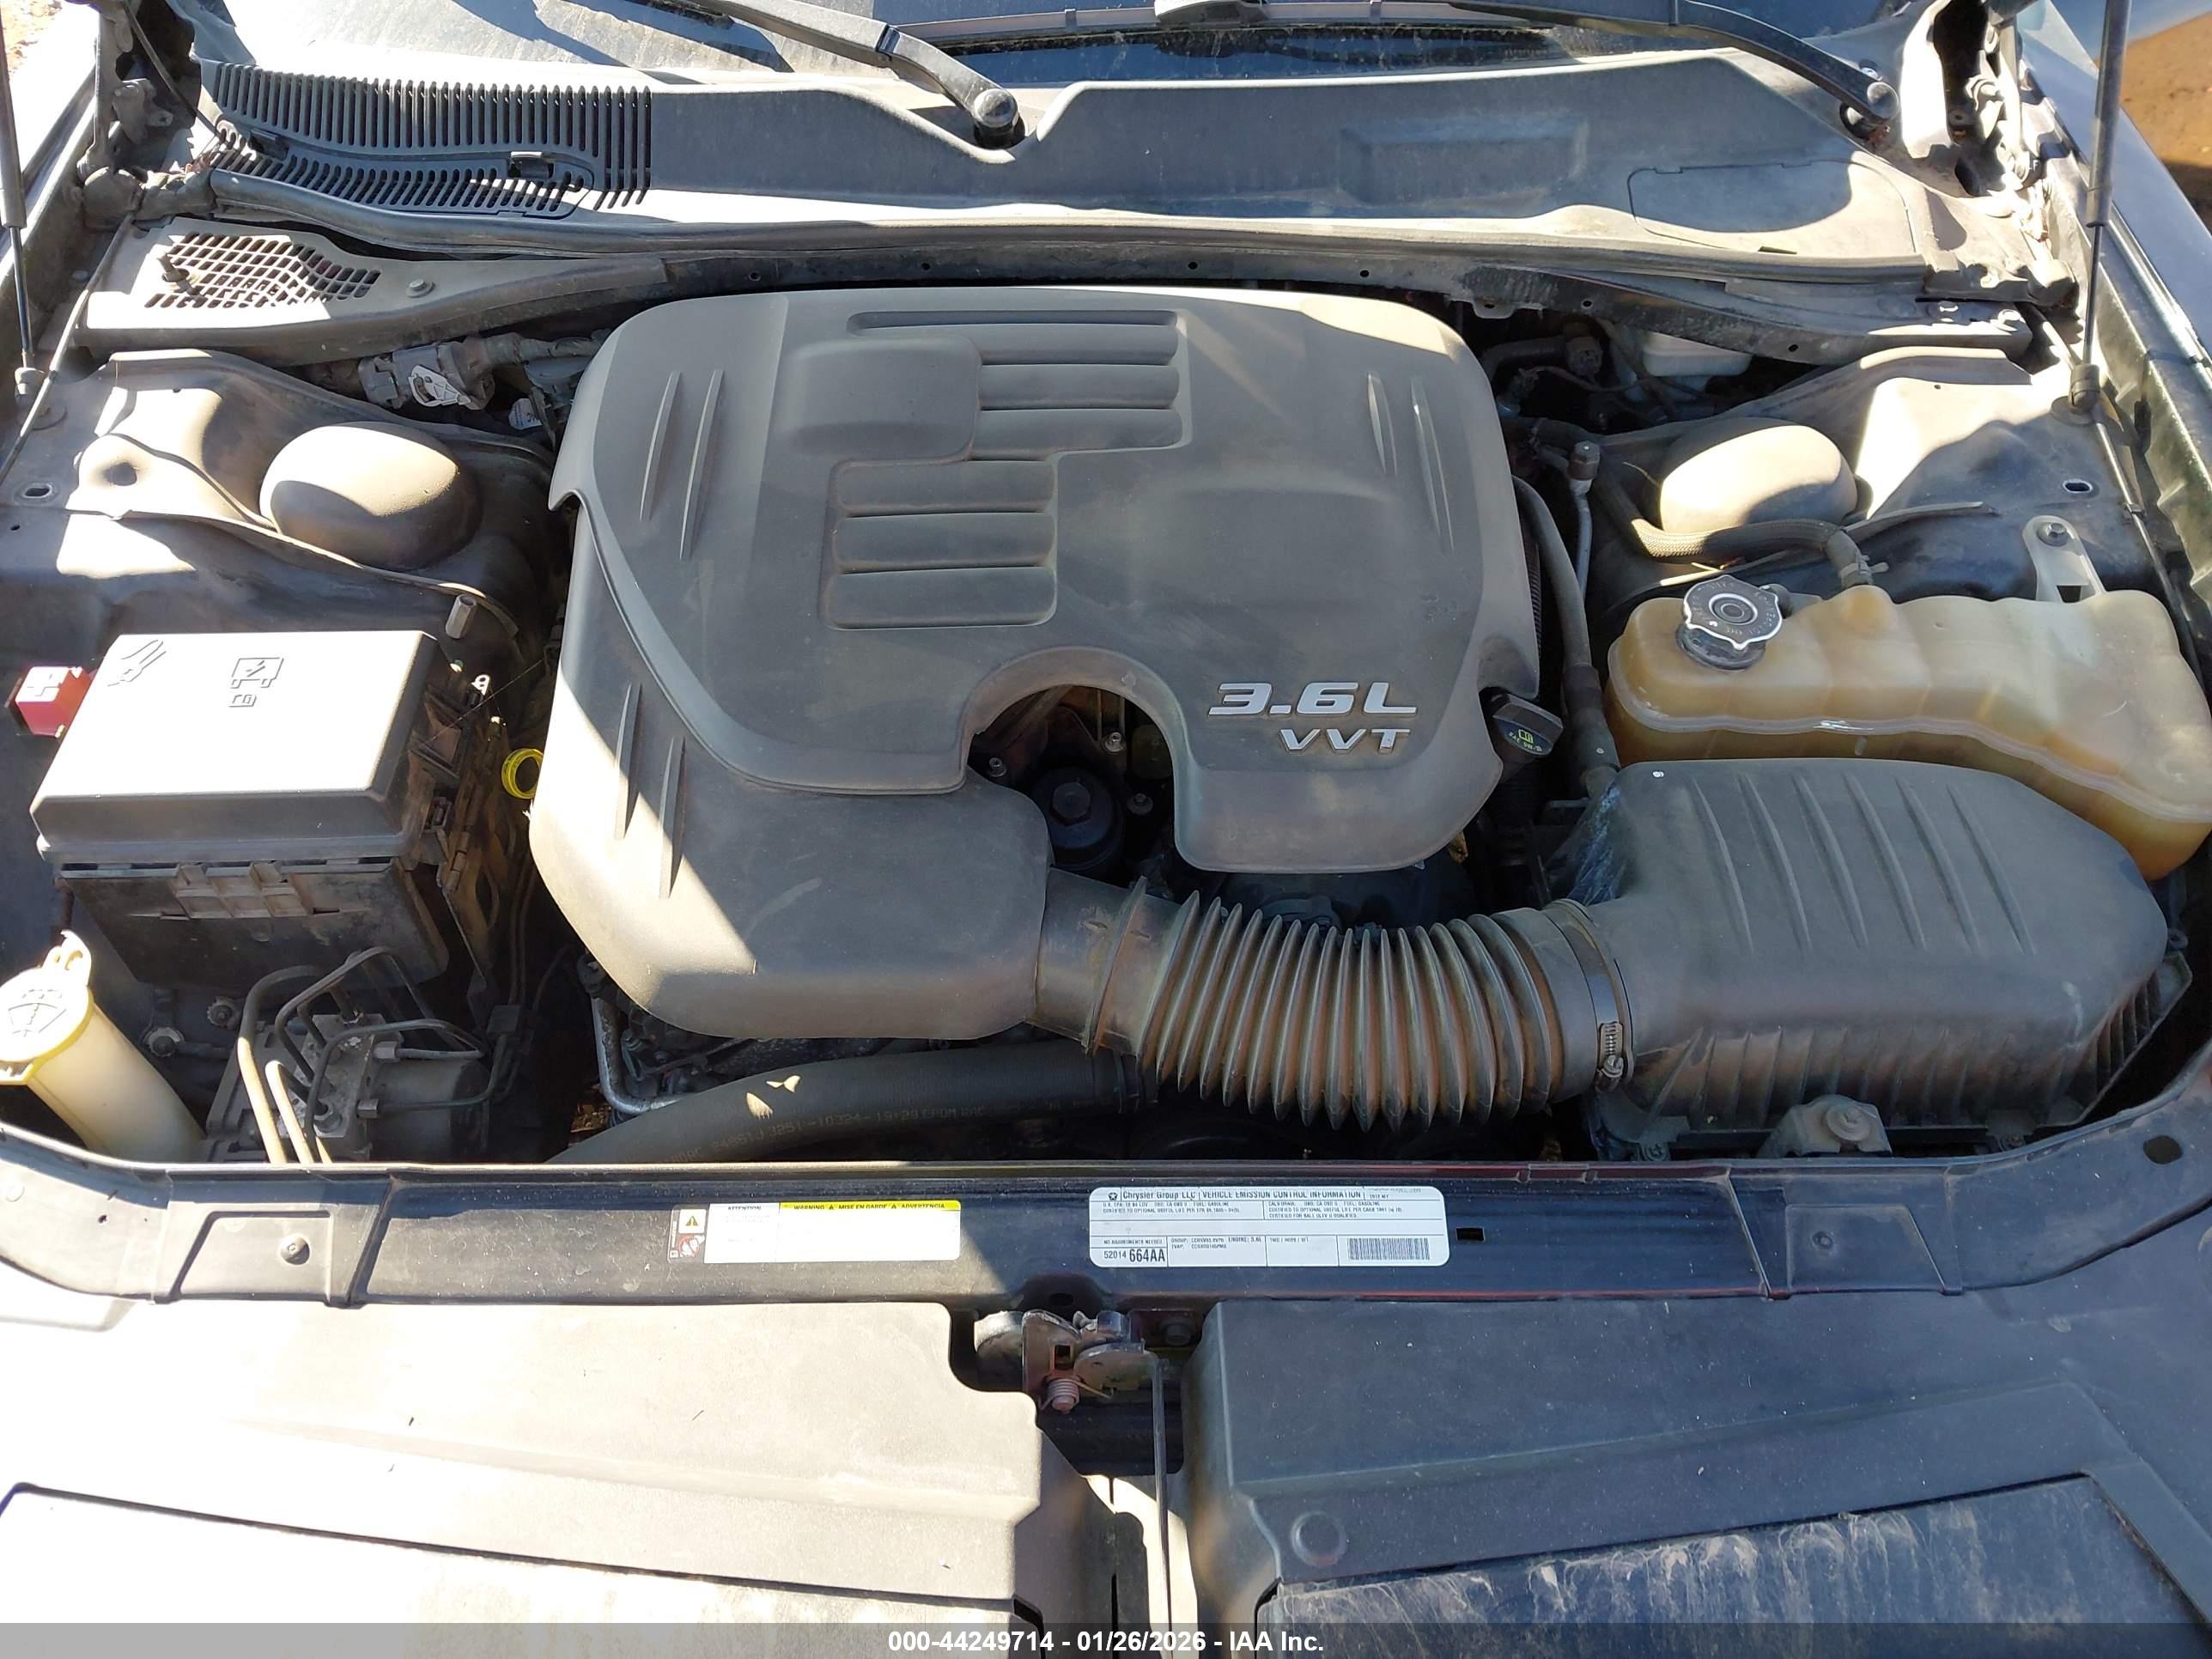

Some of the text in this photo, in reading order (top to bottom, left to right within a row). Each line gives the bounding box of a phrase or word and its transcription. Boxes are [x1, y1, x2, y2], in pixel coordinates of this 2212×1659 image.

[1208, 682, 1417, 715] 3.6L
[1279, 728, 1411, 752] VVT
[1122, 1191, 1196, 1201] Chrysler Group LLC
[1273, 1190, 1307, 1199] CONTROL
[1103, 1250, 1127, 1259] 52014
[1129, 1249, 1166, 1262] 664AA
